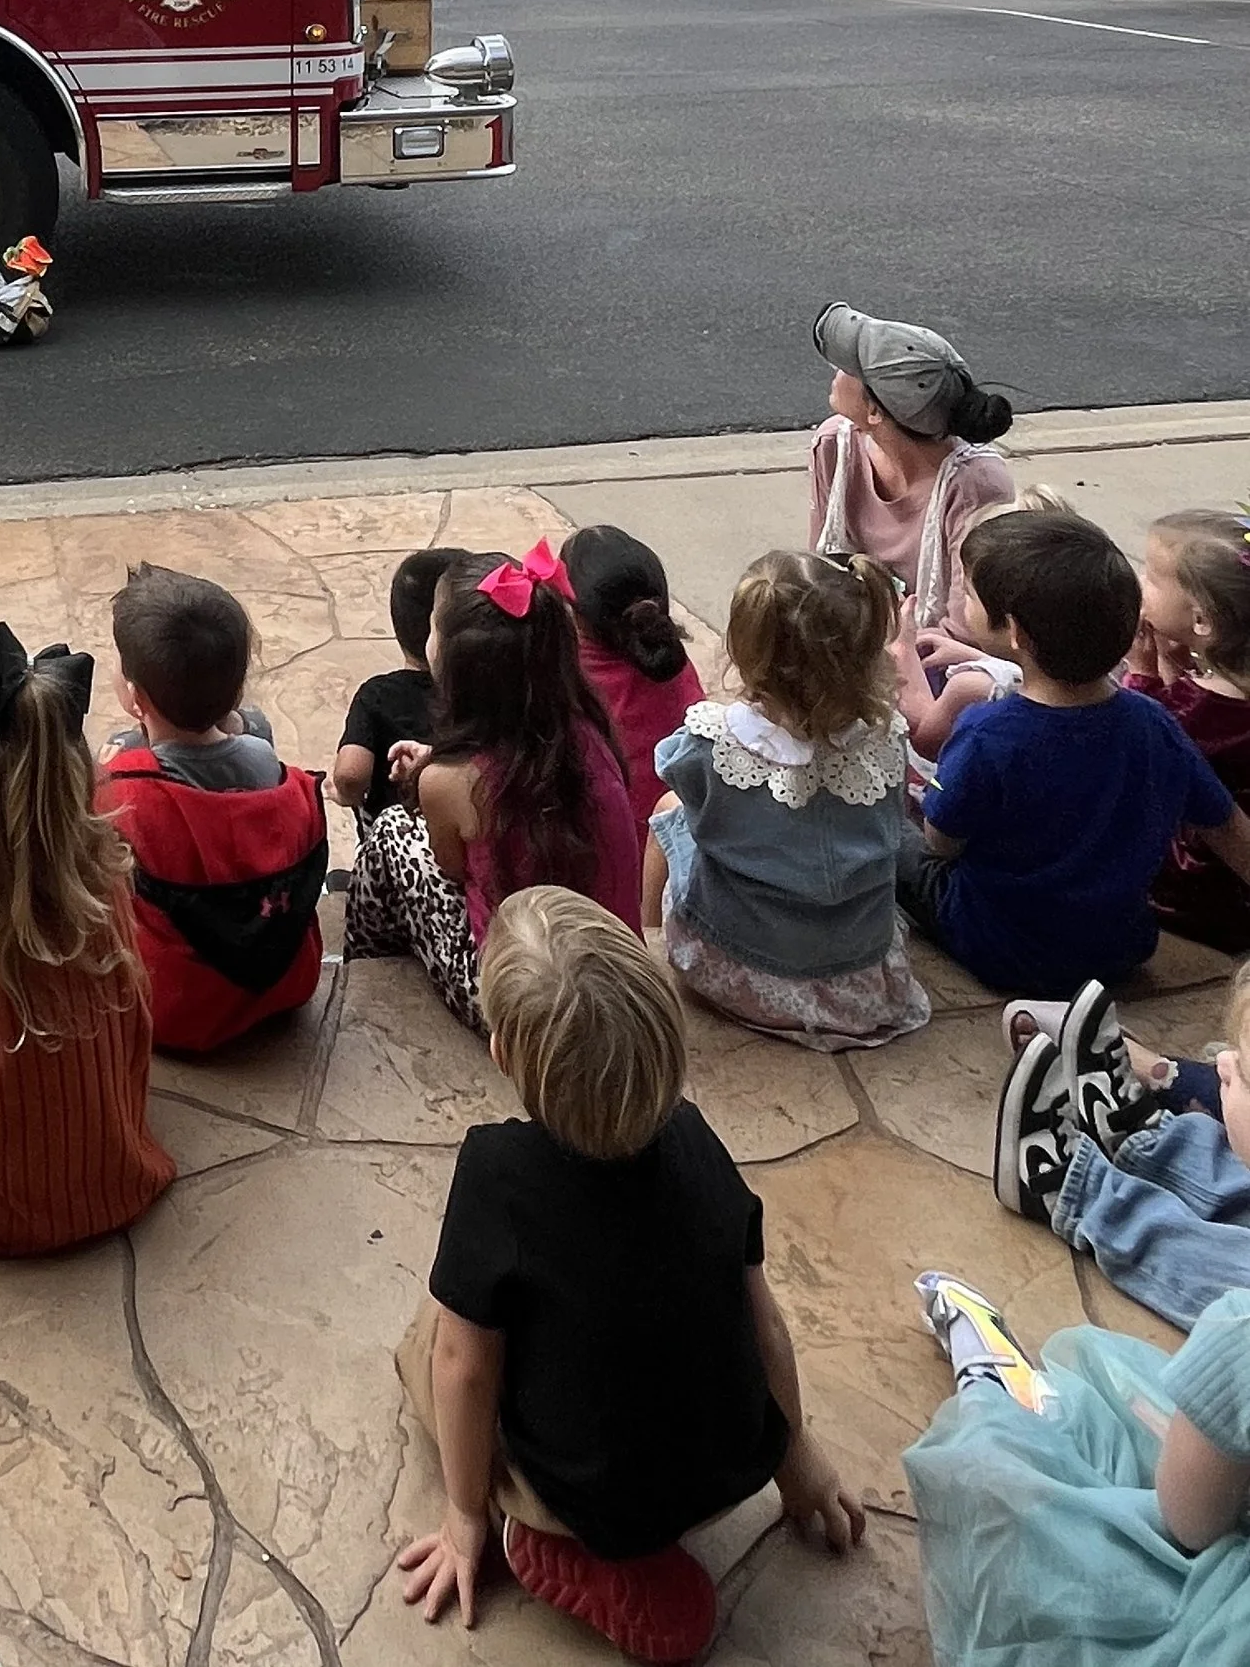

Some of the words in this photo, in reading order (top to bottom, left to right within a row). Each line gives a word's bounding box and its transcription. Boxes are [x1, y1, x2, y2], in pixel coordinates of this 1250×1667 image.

[137, 4, 168, 26] FIRE
[173, 3, 224, 28] RESCUE
[295, 60, 312, 74] 11
[318, 59, 336, 73] 53
[342, 57, 354, 71] 14
